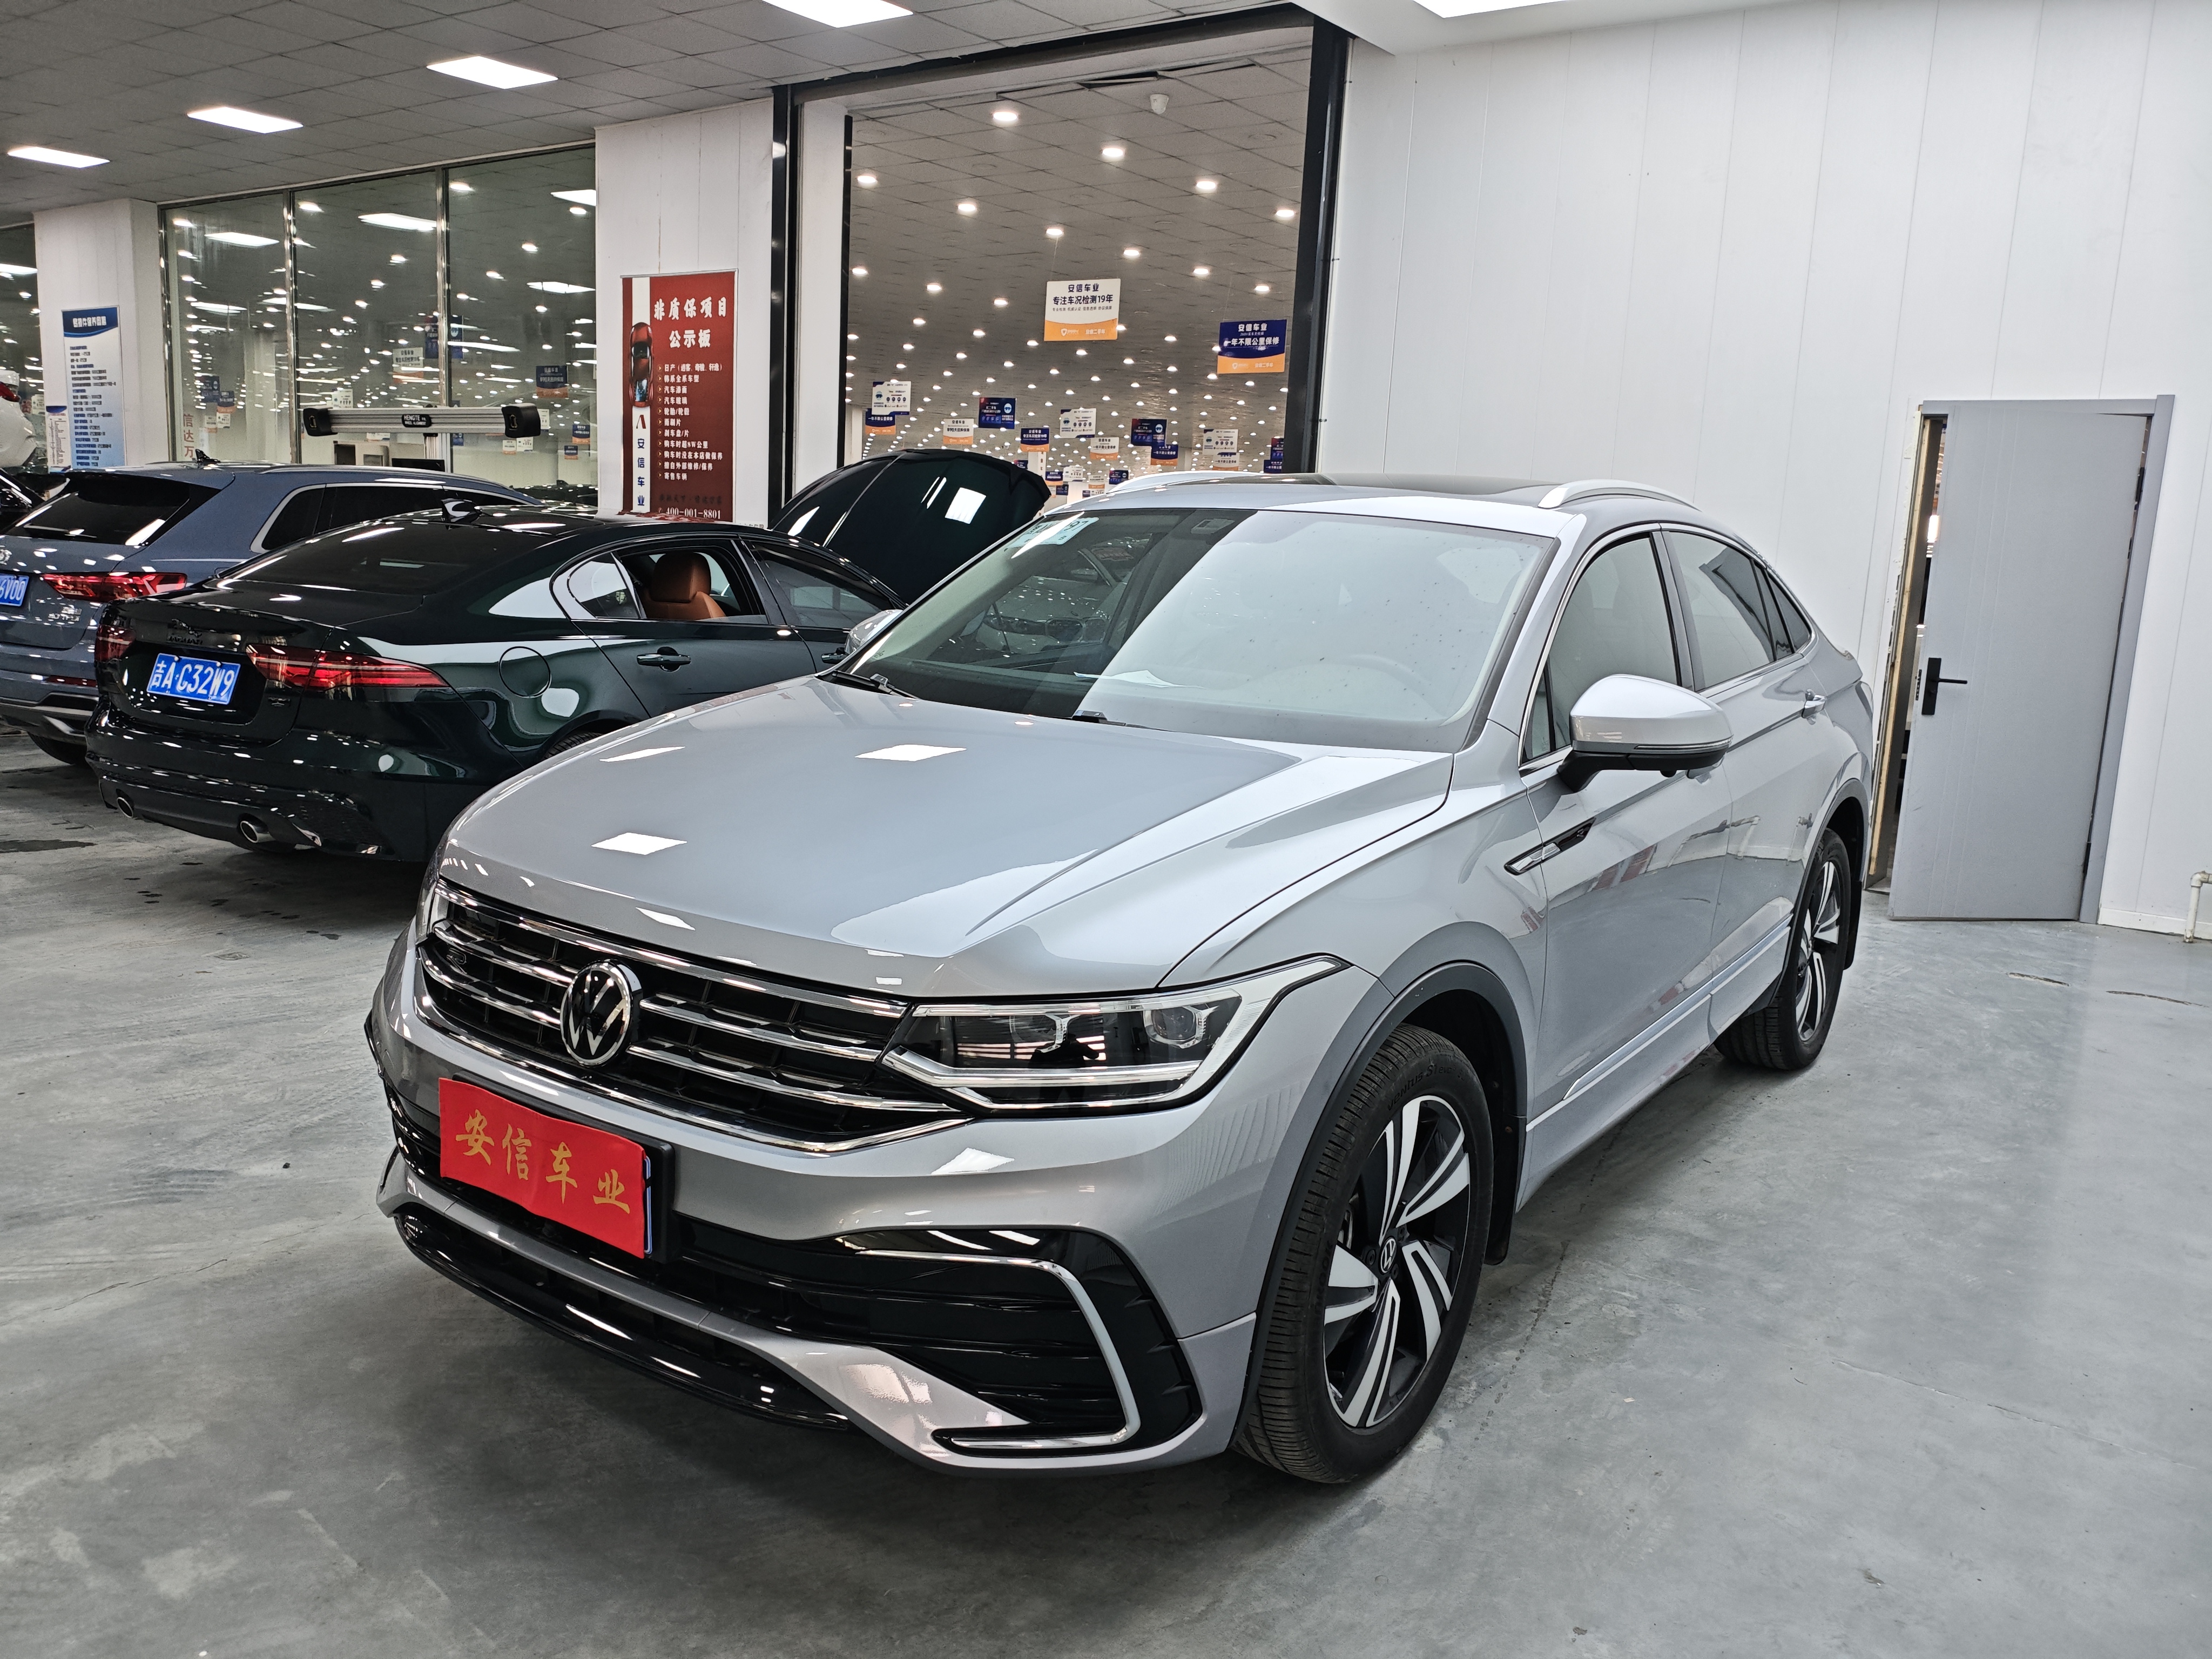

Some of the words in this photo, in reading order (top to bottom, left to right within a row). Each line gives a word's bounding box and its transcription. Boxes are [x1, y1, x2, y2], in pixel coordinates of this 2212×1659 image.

[1068, 283, 1099, 293] 安信车业
[1053, 294, 1113, 305] 专注车况检测19年
[654, 296, 726, 321] 非质保项目
[1238, 323, 1267, 332] 安信车业
[669, 328, 711, 348] 公示板
[664, 440, 708, 449] 购车时超8W公里
[666, 507, 721, 520] 400-001-8801
[455, 1109, 630, 1215] 安信车业
